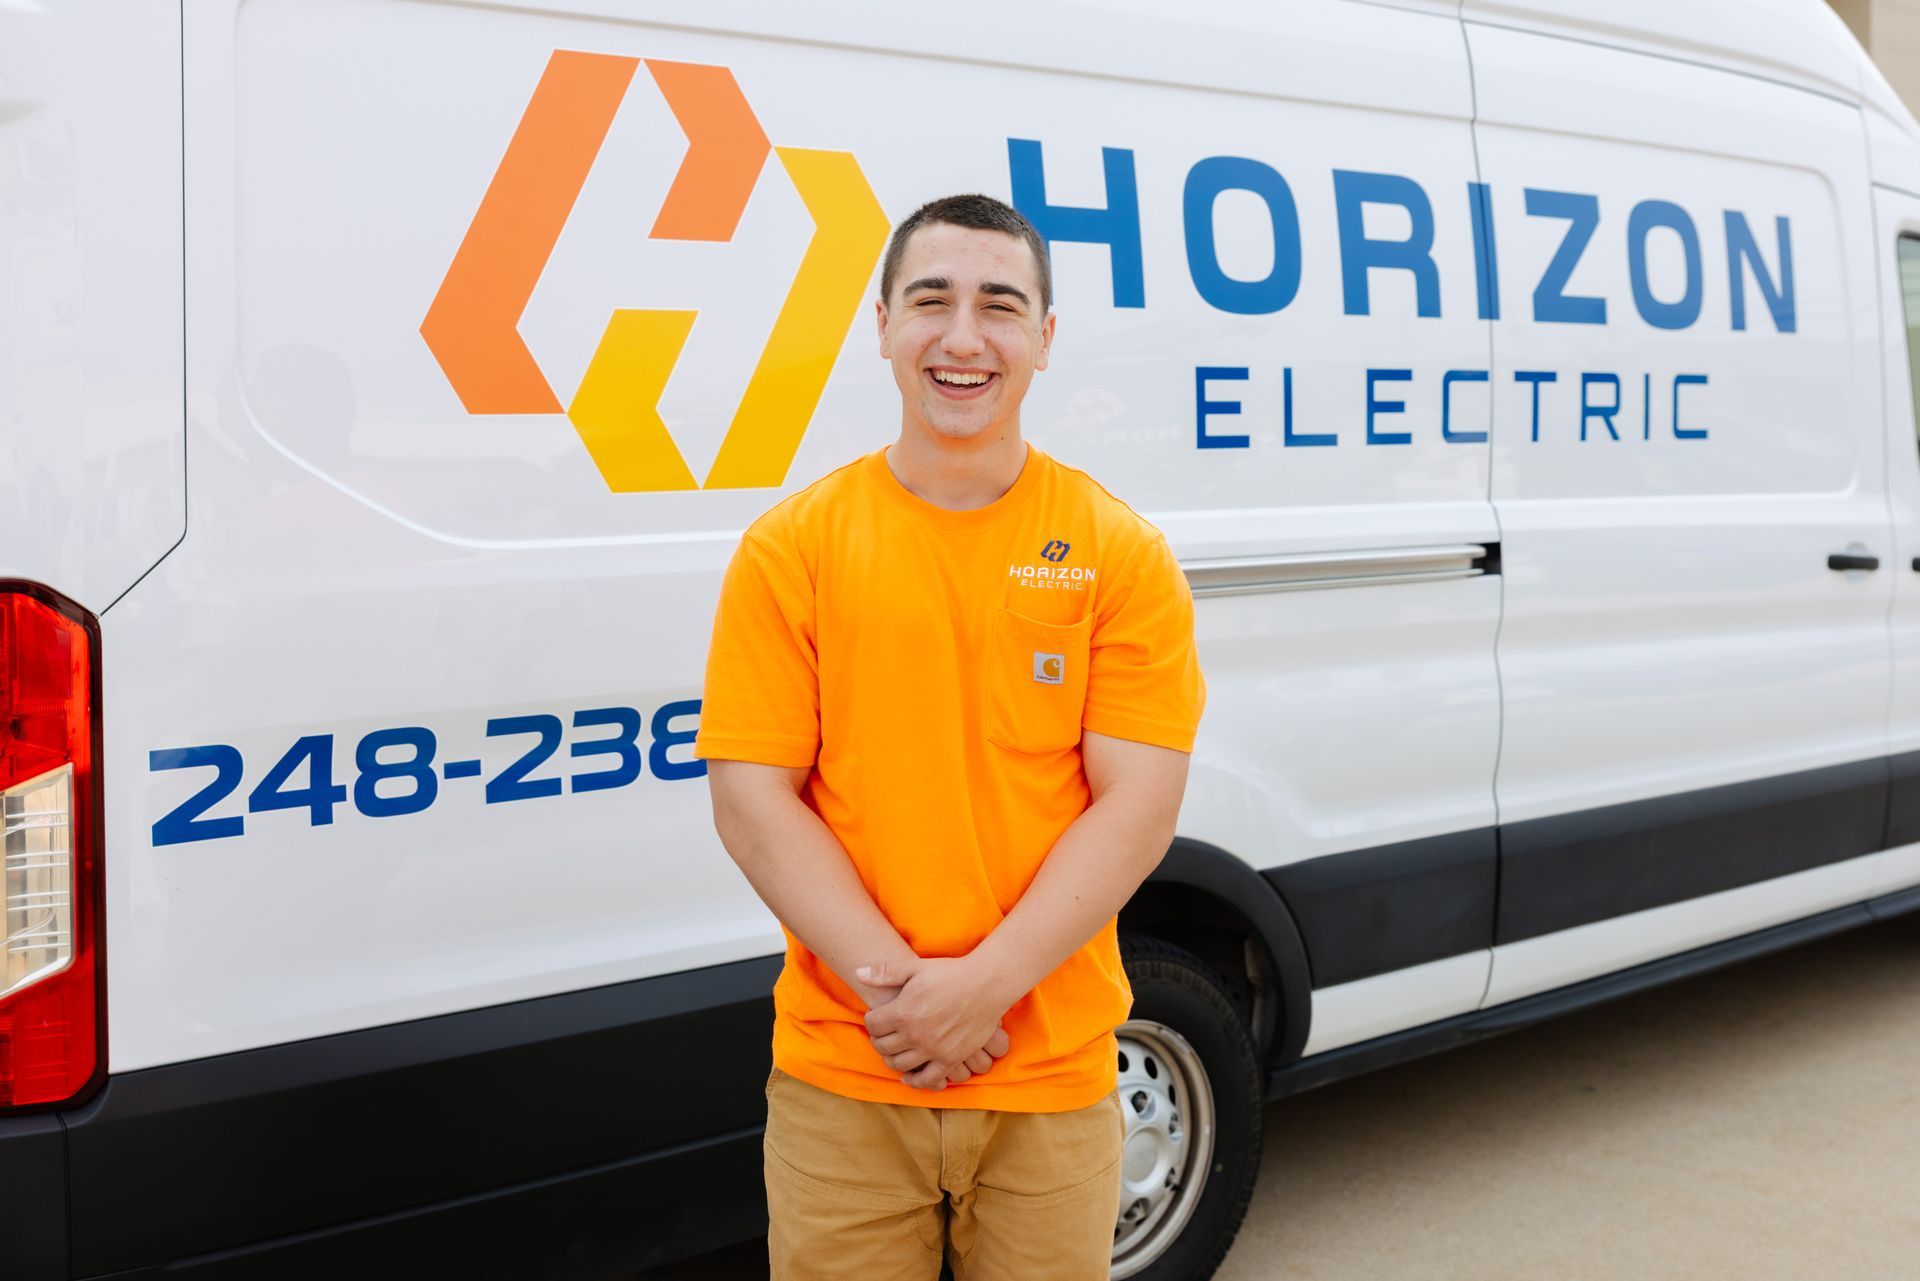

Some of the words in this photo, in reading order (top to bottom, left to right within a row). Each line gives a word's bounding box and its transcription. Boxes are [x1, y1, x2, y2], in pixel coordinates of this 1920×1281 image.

[1007, 137, 1798, 333] HORIZON
[1195, 366, 1709, 449] ELECTRIC
[1009, 564, 1097, 581] HORIZON
[1021, 578, 1084, 591] ELECTRIC
[149, 698, 708, 847] 248-238
